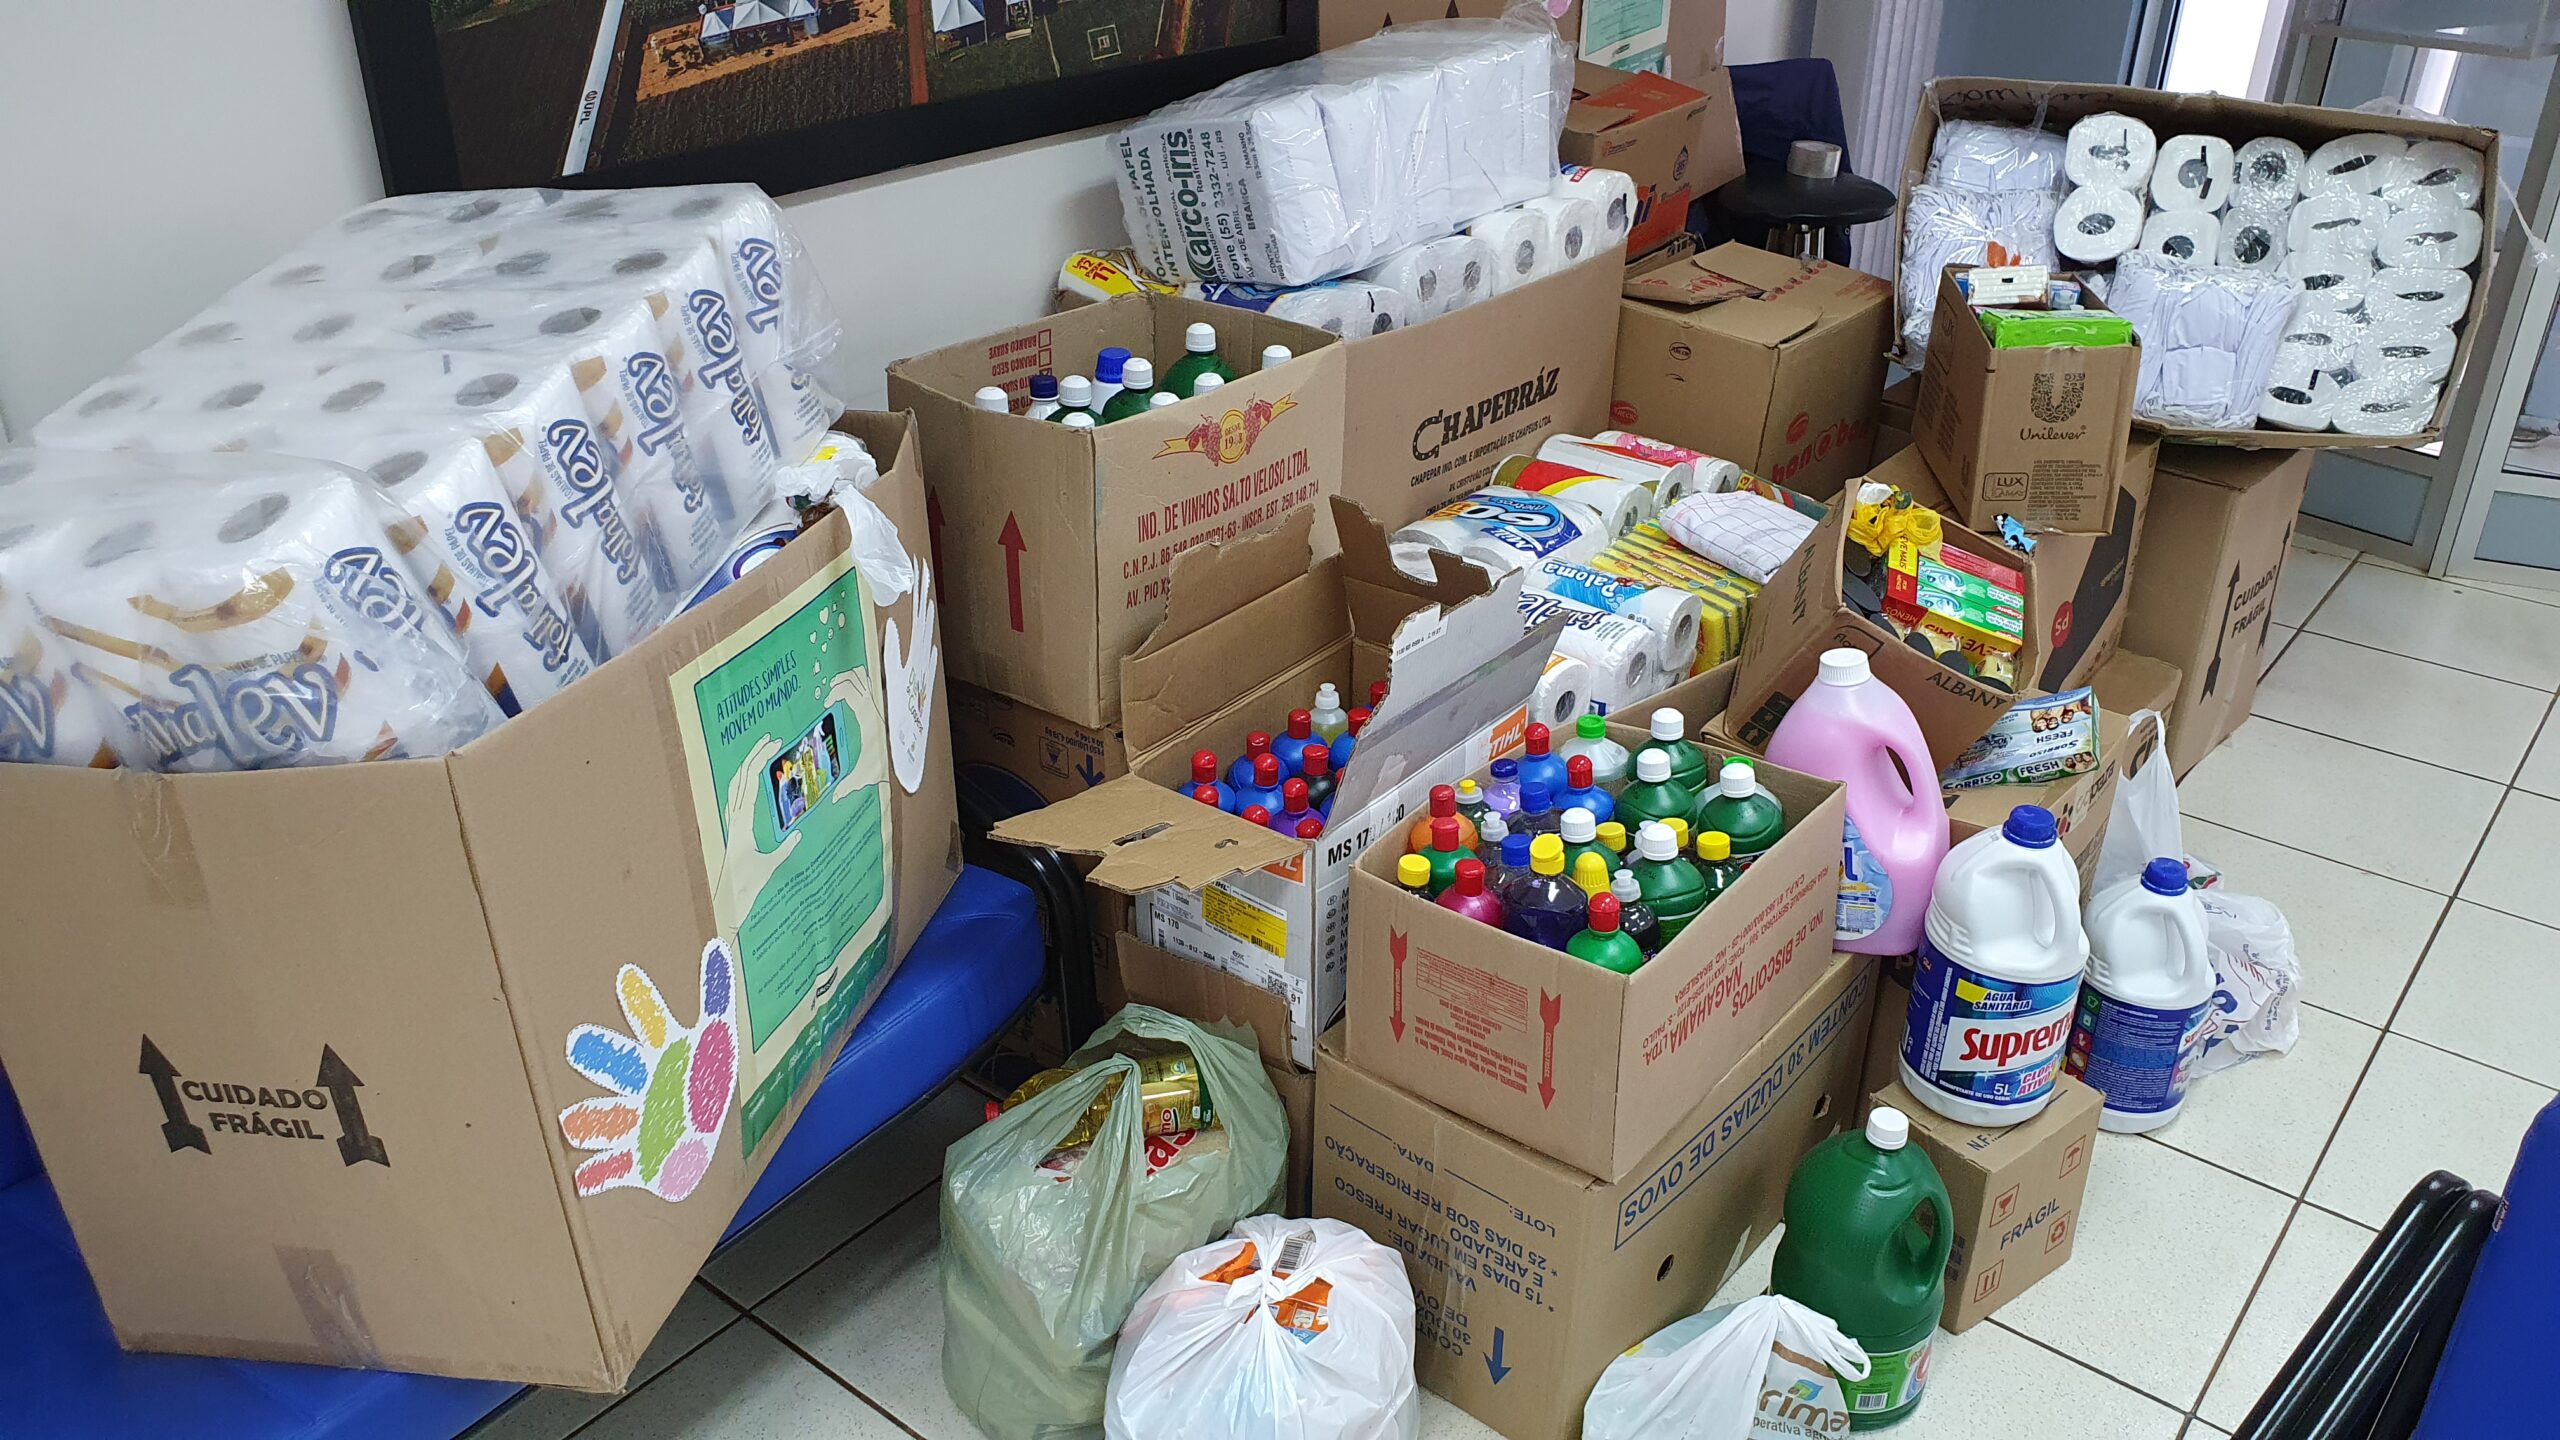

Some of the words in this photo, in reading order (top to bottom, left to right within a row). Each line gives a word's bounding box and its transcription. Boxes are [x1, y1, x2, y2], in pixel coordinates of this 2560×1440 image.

[579, 102, 595, 126] UPL
[1187, 128, 1203, 193] Resfriadores
[1200, 131, 1226, 208] 3332-7248
[1138, 147, 1180, 277] INTERFOLHADA
[1171, 190, 1187, 244] COMERCIAL
[1218, 212, 1234, 240] (55)
[1226, 244, 1243, 280] Fone
[988, 343, 1009, 360] SUAVE
[1010, 335, 1037, 353] BRANCO
[992, 361, 1009, 376] SECO
[1010, 354, 1037, 372] BRANCO
[2020, 427, 2085, 441] Unilever
[1411, 466, 1441, 487] CHAPEPAR
[1508, 433, 1514, 446] DE
[1137, 511, 1161, 544] IND.
[1164, 503, 1178, 534] DE
[1181, 487, 1220, 527] VINHOS
[1222, 475, 1251, 512] SALTO
[1253, 459, 1285, 498] VELOSO
[1287, 448, 1311, 481] LTDA.
[1997, 477, 2024, 487] LUX
[1497, 498, 1548, 512] metros
[1123, 555, 1158, 580] C.N.P.J.
[1242, 507, 1265, 531] INSCR.
[1266, 499, 1280, 520] EST.
[1899, 551, 1908, 569] MAIS
[1126, 586, 1141, 609] AV.
[1144, 579, 1158, 602] PIO
[1543, 562, 1620, 597] Paloma
[2233, 565, 2277, 612] CUIDADO
[1885, 606, 1918, 623] MENOS
[2231, 597, 2266, 639] FRÁGIL
[1926, 671, 2007, 710] ALBANY
[720, 715, 756, 747] MOVEM
[757, 706, 765, 720] O
[2036, 729, 2074, 745] FRESH
[2028, 739, 2080, 759] SORRISO
[1943, 771, 2003, 790] SORRISO
[2019, 760, 2061, 777] FRESH
[1327, 838, 1353, 868] MS
[1154, 911, 1165, 923] MS
[1168, 917, 1180, 930] 170
[1809, 909, 1824, 934] IND.
[1795, 929, 1806, 949] DE
[1732, 938, 1793, 1018] BISCOITOS
[1670, 961, 1743, 1053] NAGAHAMA
[1973, 1000, 2031, 1011] SANITÁRIA
[1984, 991, 2015, 1002] ÁGUA
[1642, 1022, 1667, 1049] PAULO
[1642, 1034, 1670, 1066] LTDA.
[1787, 1048, 1805, 1076] 30
[181, 1080, 327, 1110] CUIDADO
[1993, 1083, 2011, 1095] 5L
[1720, 1069, 1784, 1144] DÚZIAS
[208, 1112, 324, 1140] FRÁGIL
[1392, 1141, 1434, 1173] DATA:
[1689, 1135, 1715, 1173] DE
[1324, 1135, 1442, 1213] REFRIGERAÇÃO
[1334, 1177, 1393, 1220] FRESCO
[1623, 1157, 1685, 1229] OVOS
[1446, 1207, 1479, 1234] SOB
[1509, 1203, 1556, 1238] LOTE:
[1398, 1217, 1449, 1256] LUGAR
[1485, 1226, 1524, 1257] DIAS
[1387, 1229, 1477, 1293] VALIDADE:
[1450, 1227, 1528, 1281] AREJADO
[1454, 1250, 1478, 1272] EM
[1528, 1252, 1547, 1270] 25
[1482, 1265, 1520, 1296] DIAS
[1533, 1273, 1544, 1288] E
[1525, 1287, 1543, 1306] 15
[1444, 1307, 1468, 1328] DE
[1453, 1328, 1472, 1346] 30
